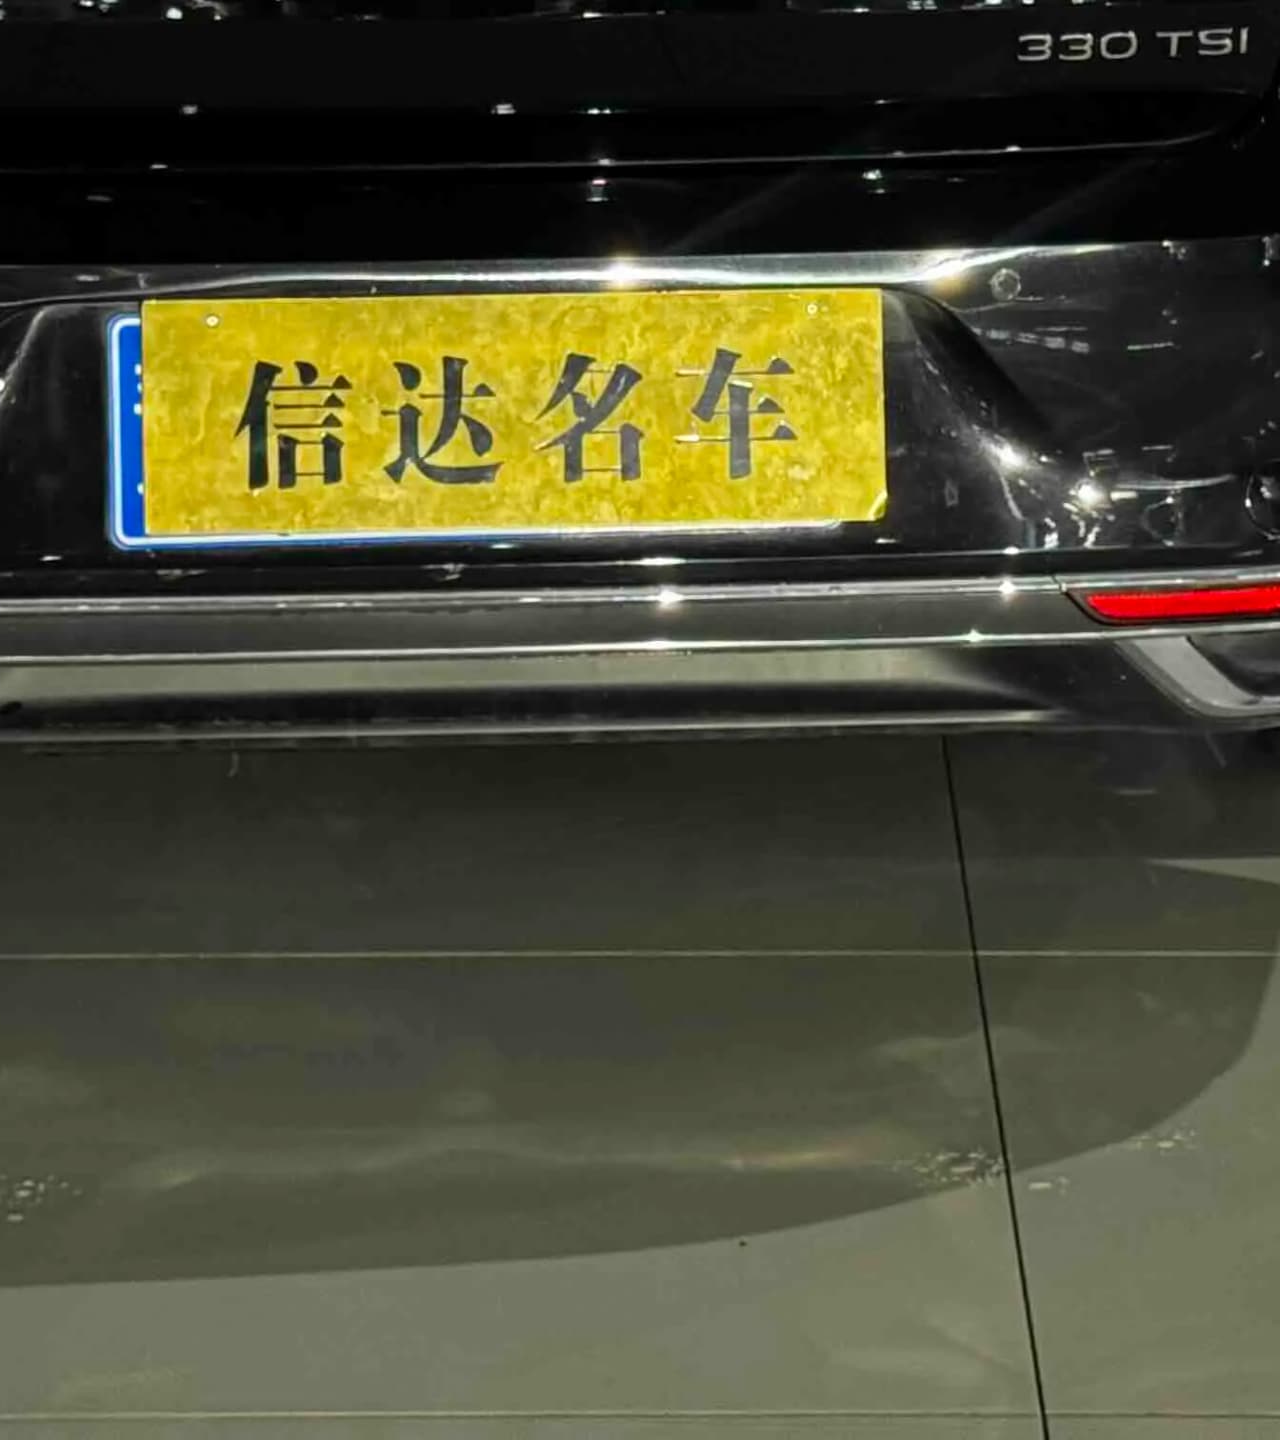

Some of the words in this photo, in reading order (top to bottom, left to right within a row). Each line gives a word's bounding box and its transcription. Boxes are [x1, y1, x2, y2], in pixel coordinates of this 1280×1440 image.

[1017, 30, 1139, 61] 330
[1155, 26, 1250, 58] TSI
[233, 347, 797, 491] 信达名车
